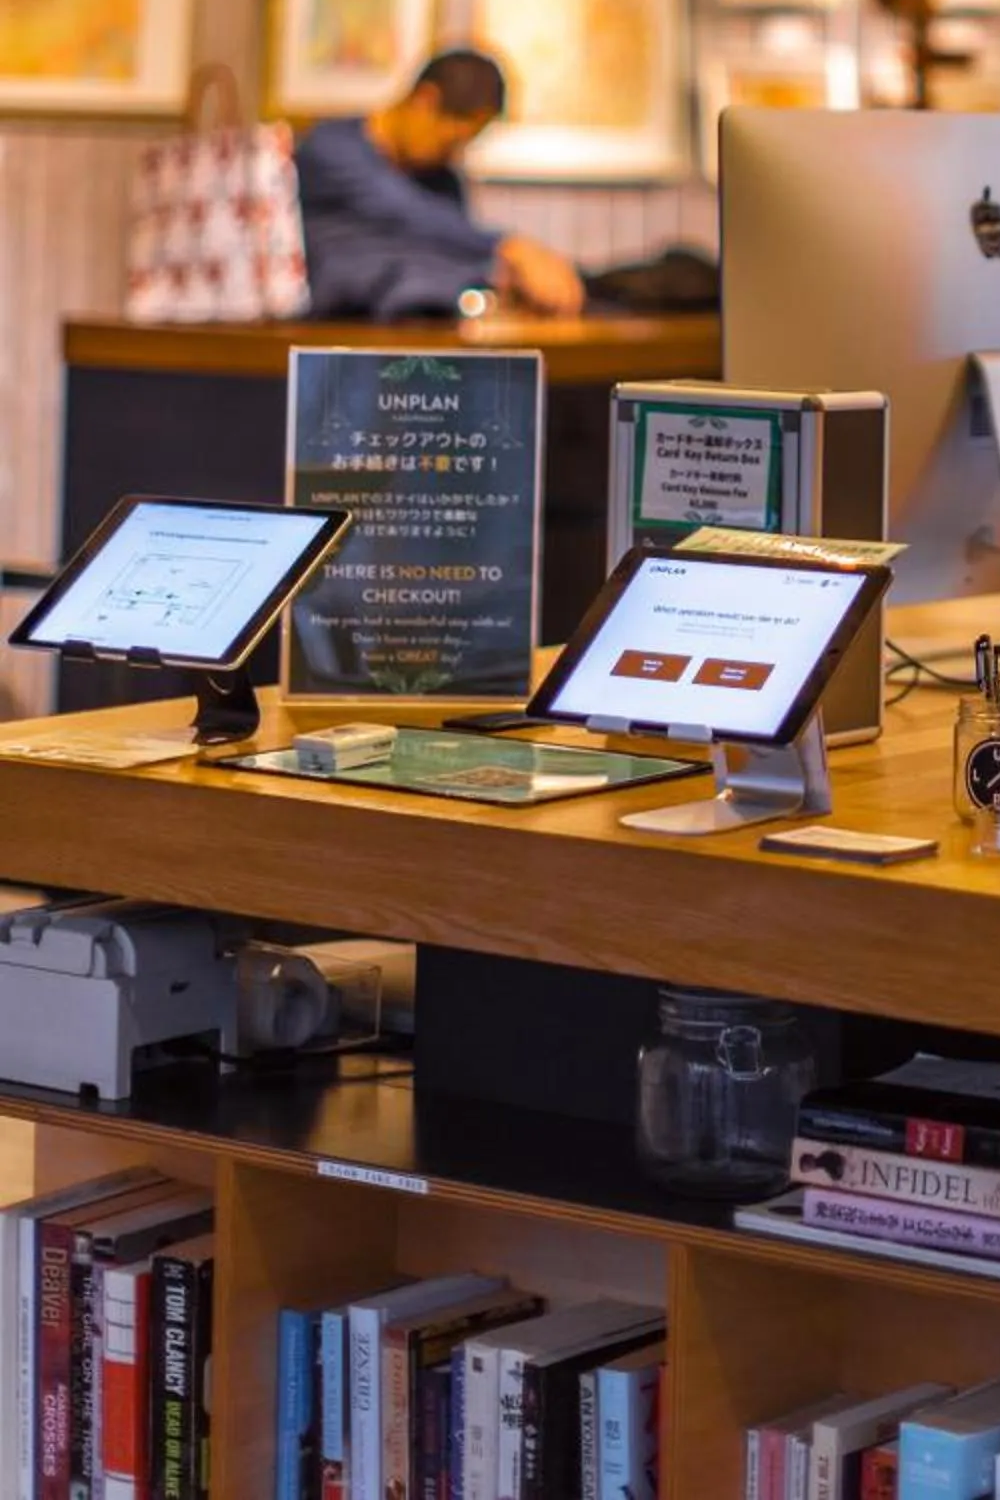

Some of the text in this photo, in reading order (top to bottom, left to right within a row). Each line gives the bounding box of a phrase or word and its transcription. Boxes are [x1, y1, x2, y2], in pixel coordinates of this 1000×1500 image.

[378, 395, 459, 411] UNPLAN
[351, 431, 486, 448] チェックアウトの
[657, 448, 679, 460] Card
[685, 450, 702, 462] Key
[324, 565, 503, 581] THERE IS NO NEED TO
[362, 589, 461, 603] CHECKOUT!
[860, 1159, 978, 1205] INFIDEL
[41, 1246, 68, 1328] Deaver
[83, 1313, 93, 1344] GIRL
[166, 1285, 186, 1397] TOM CLANCY
[83, 1360, 93, 1384] ON
[43, 1394, 56, 1477] CROSSES
[166, 1402, 182, 1499] DEAD OR ALIVE
